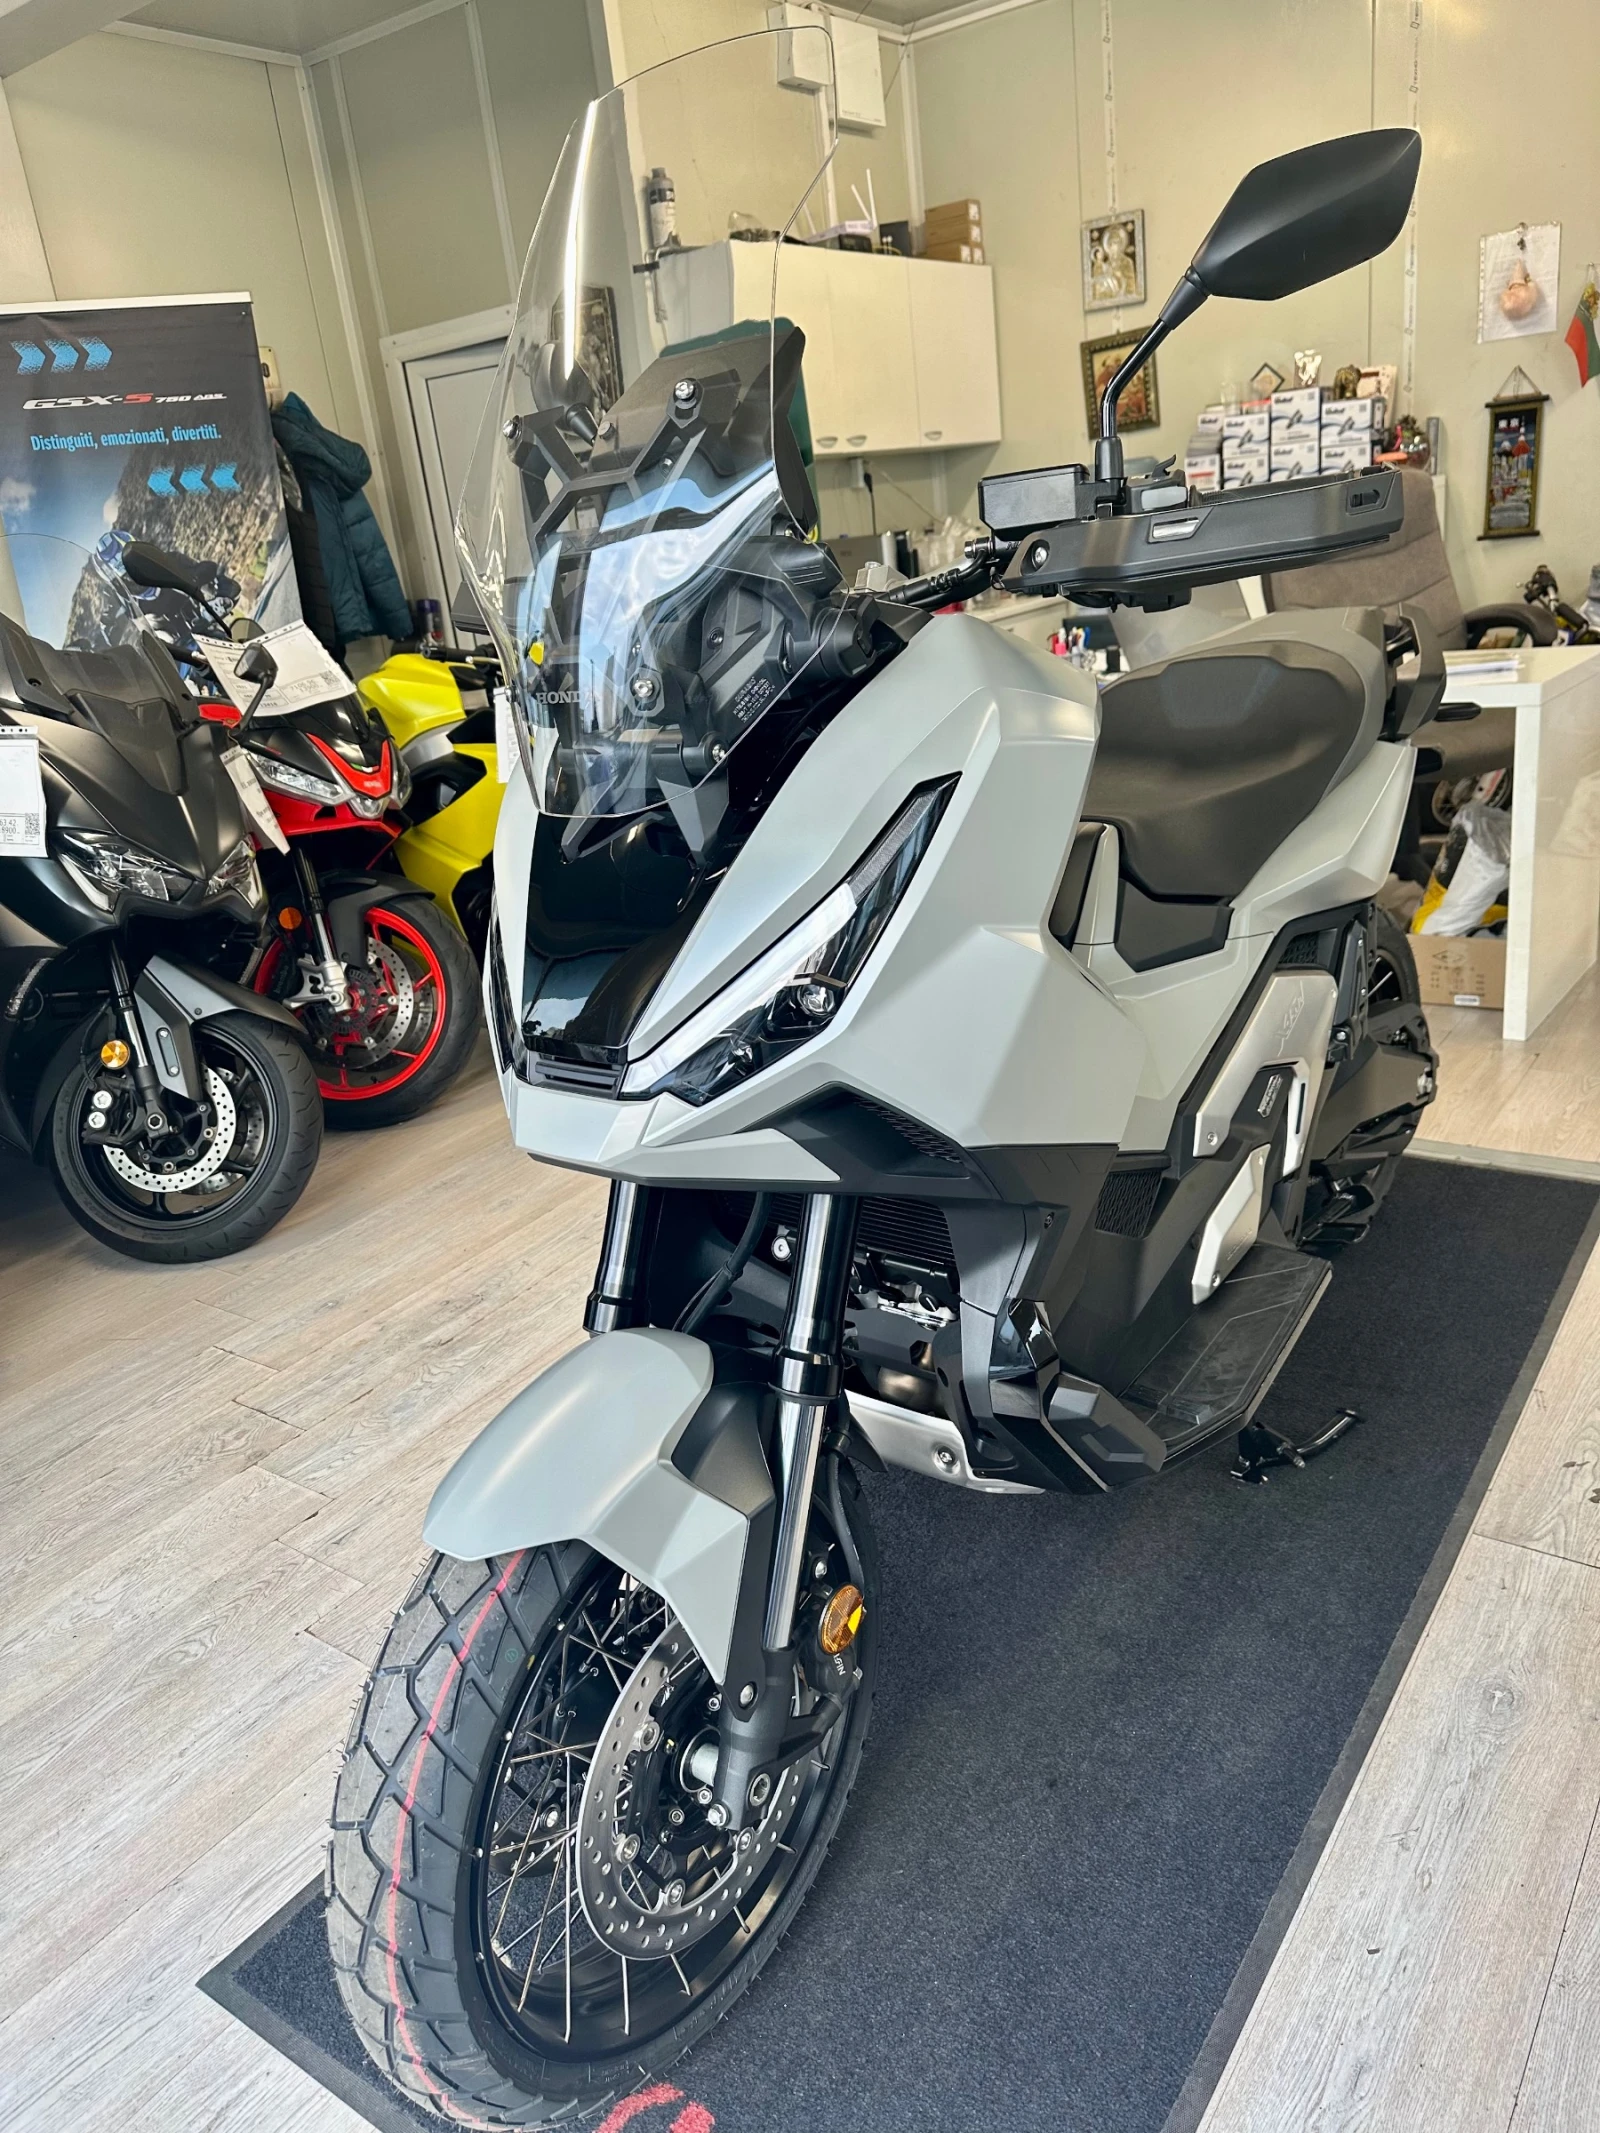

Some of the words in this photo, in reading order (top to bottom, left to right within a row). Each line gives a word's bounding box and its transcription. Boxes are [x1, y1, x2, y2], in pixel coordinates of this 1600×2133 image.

[155, 395, 192, 404] 750
[30, 431, 98, 452] Distinguiti,
[101, 427, 169, 446] emozionati,
[171, 424, 222, 443] divertiti.
